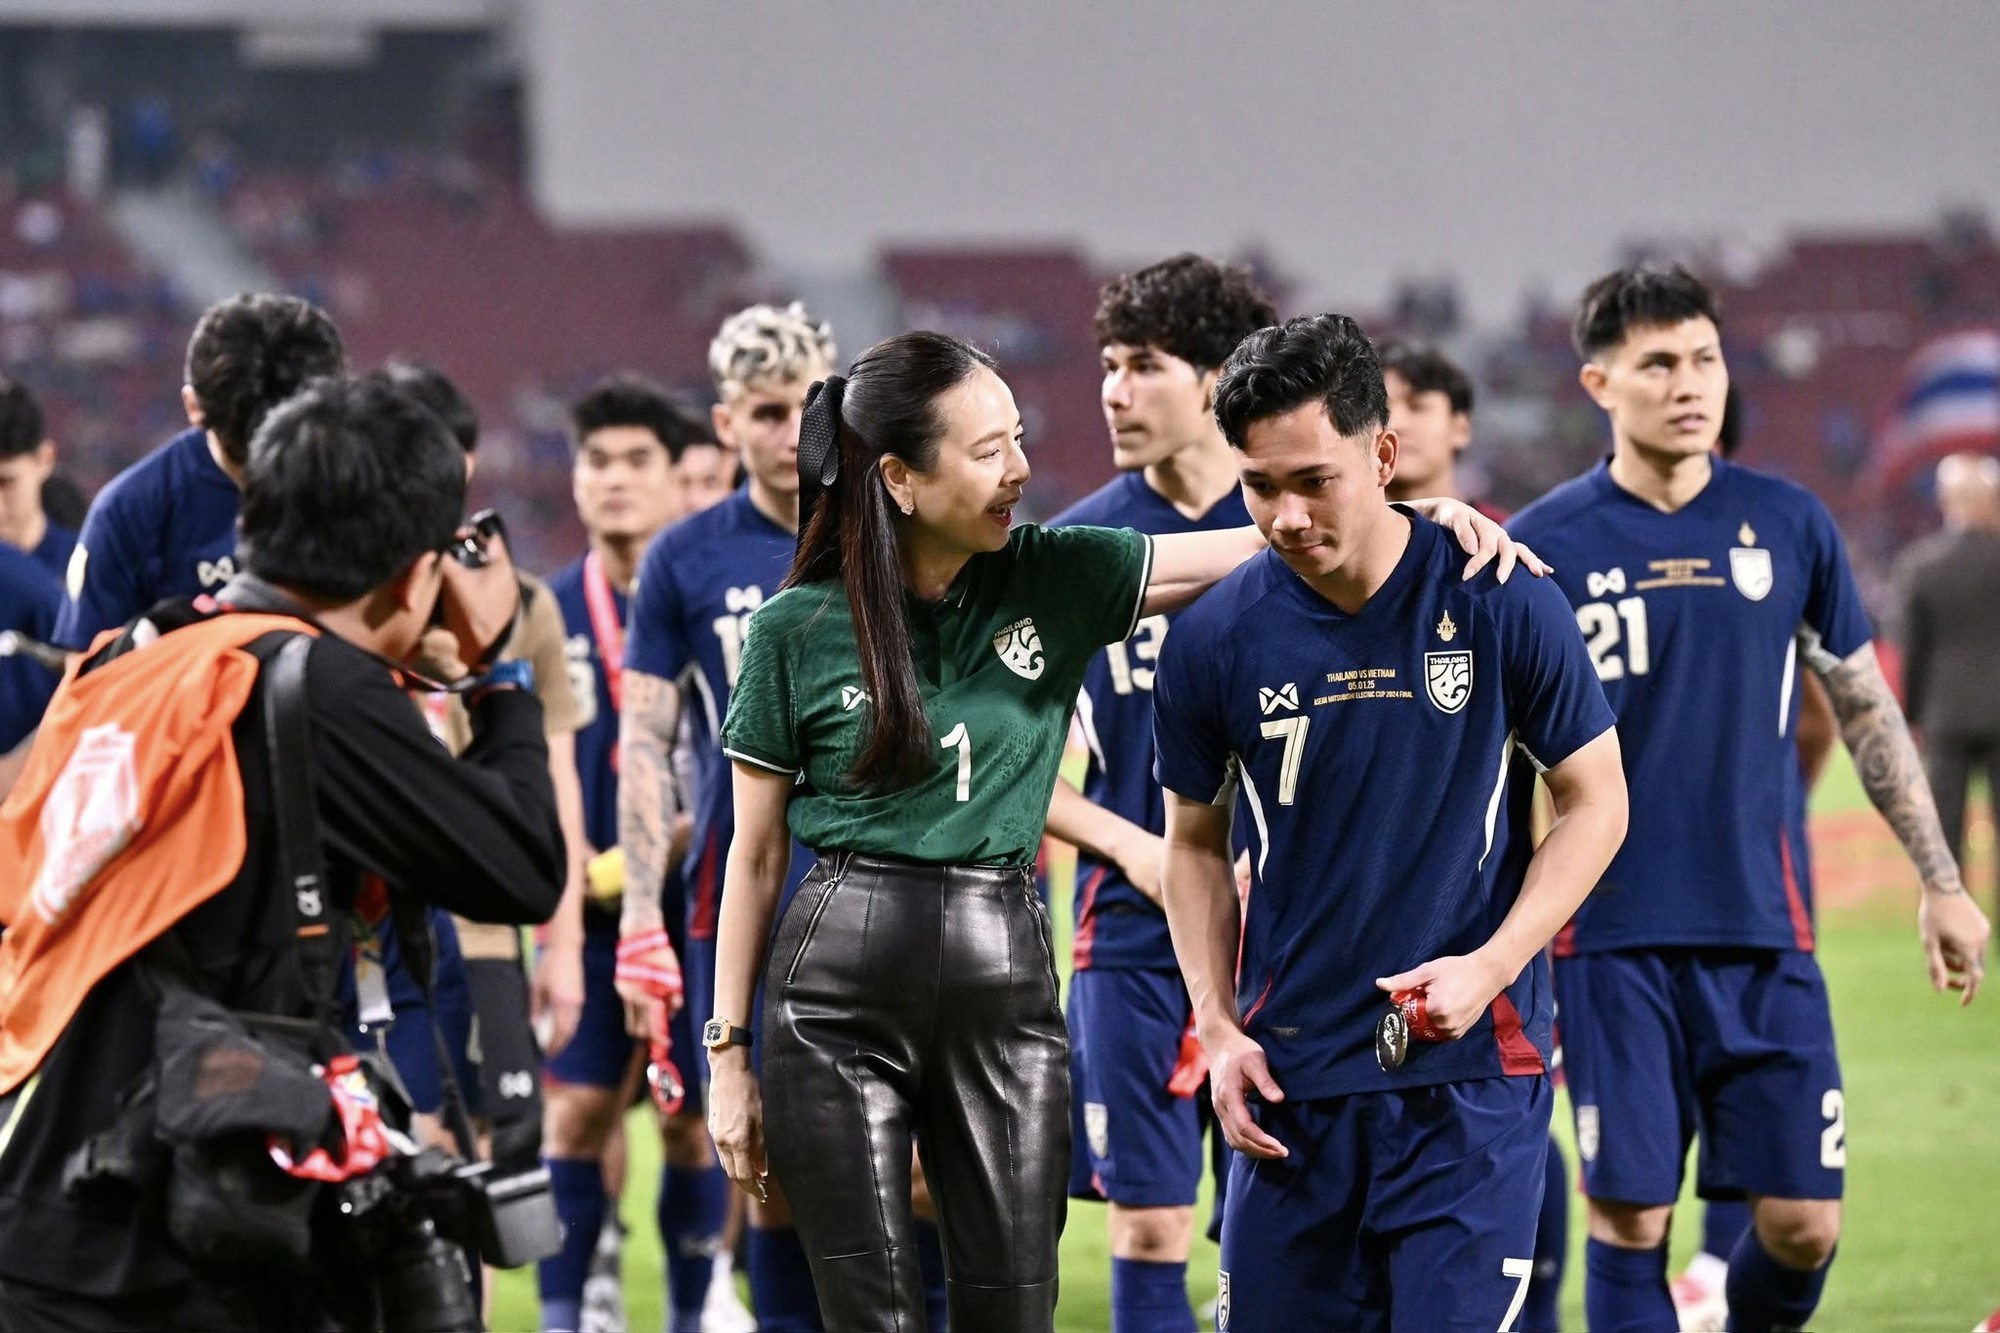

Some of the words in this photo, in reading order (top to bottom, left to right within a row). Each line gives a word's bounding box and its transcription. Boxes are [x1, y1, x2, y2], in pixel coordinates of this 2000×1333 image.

[713, 615, 751, 690] 1
[994, 617, 1033, 641] THAILAND
[1105, 614, 1170, 695] 13
[1429, 656, 1468, 665] THAILAND
[1576, 596, 1649, 681] 21
[1326, 670, 1358, 683] THAILAND
[1358, 669, 1368, 679] VS
[1368, 668, 1396, 679] VIETNAM
[1347, 680, 1376, 690] 05.01.25
[940, 722, 971, 802] 1
[1260, 715, 1310, 806] 7
[1498, 1257, 1534, 1333] 7
